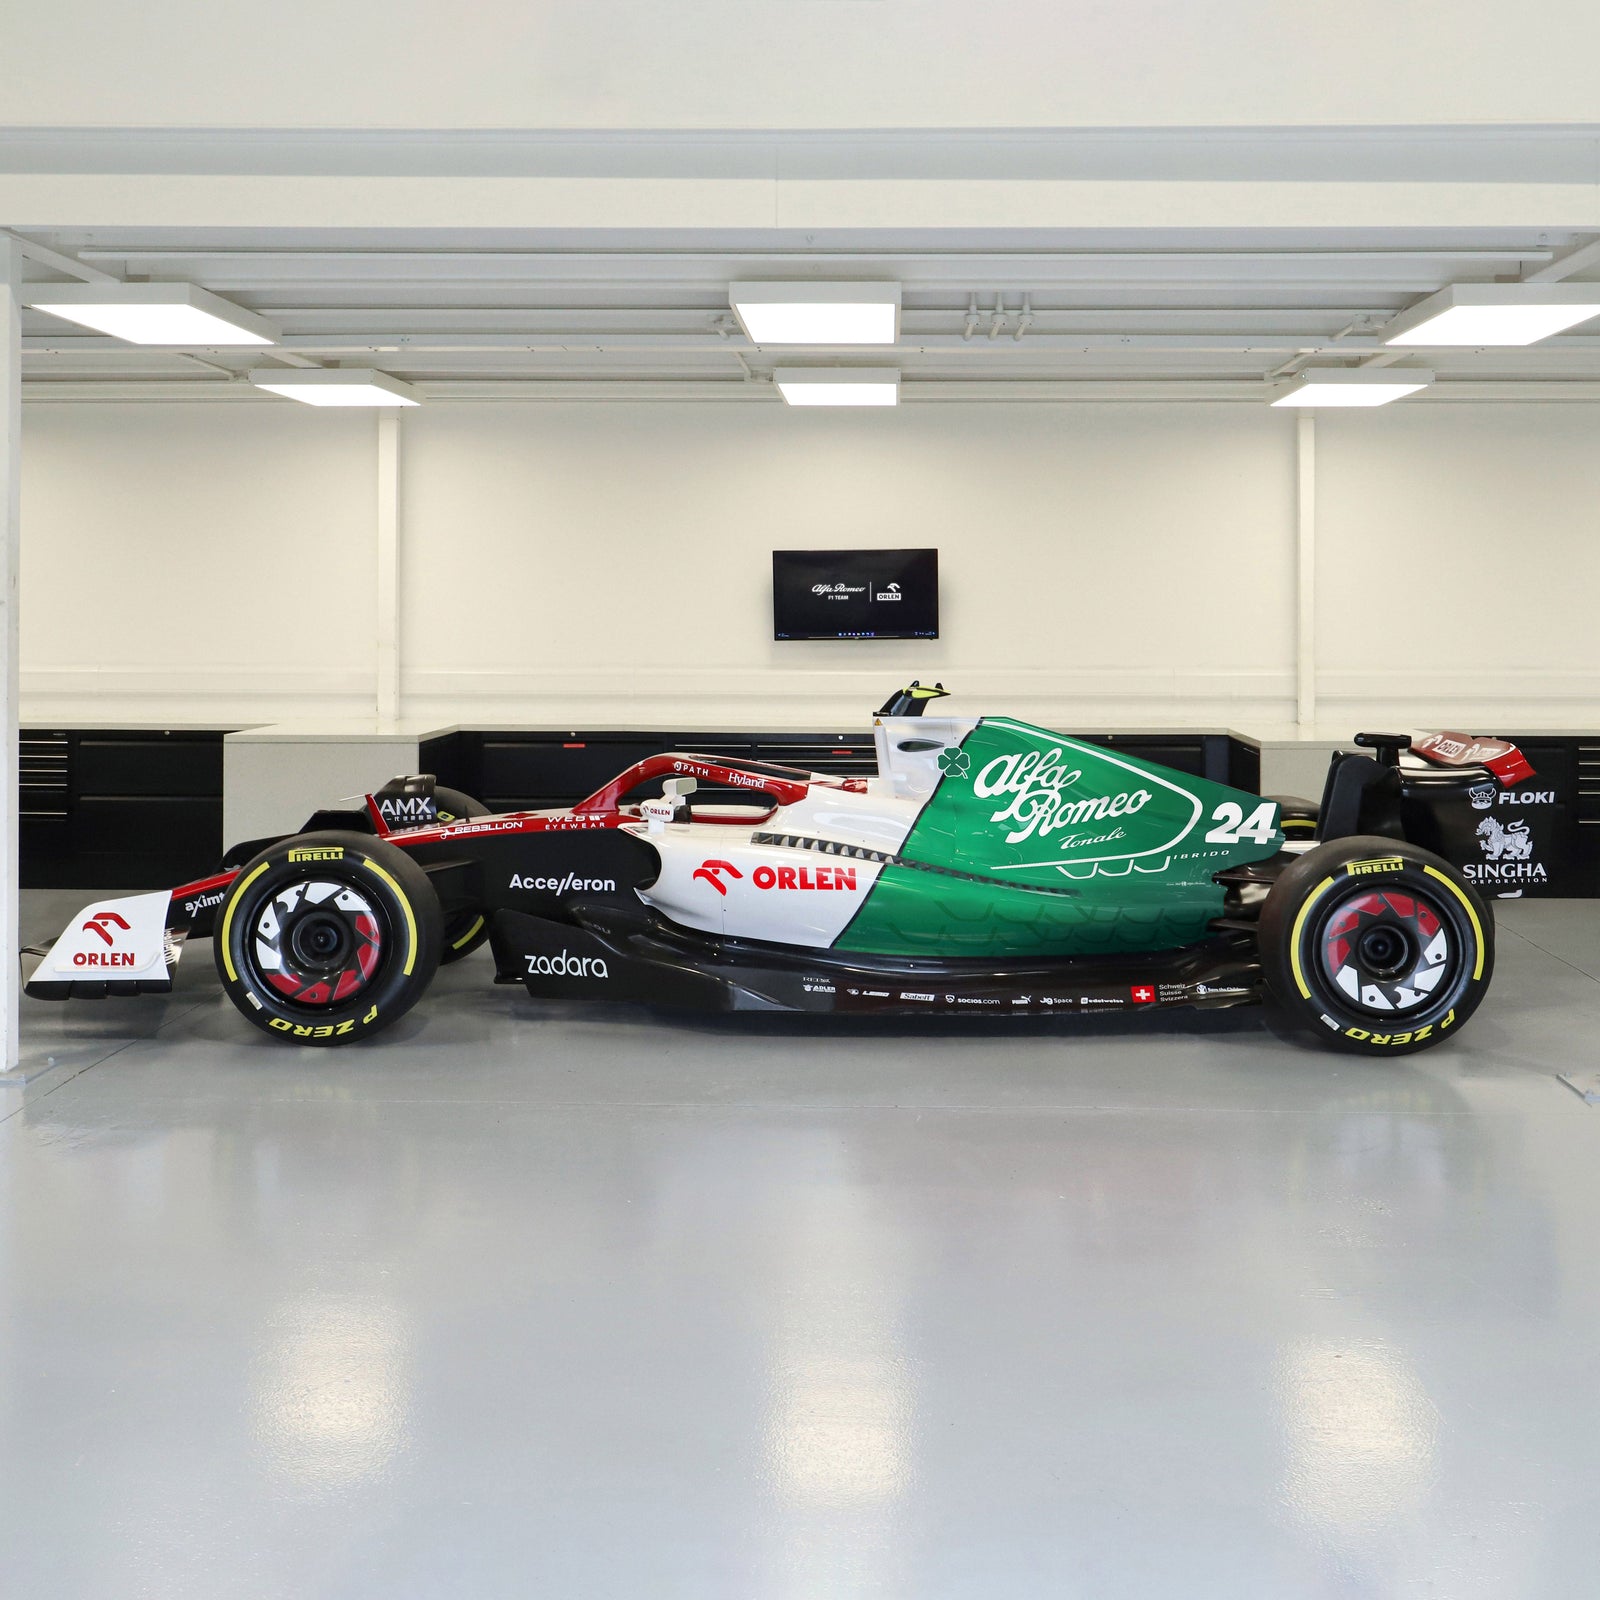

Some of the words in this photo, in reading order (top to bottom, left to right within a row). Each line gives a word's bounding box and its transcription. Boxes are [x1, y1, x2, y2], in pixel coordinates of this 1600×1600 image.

[728, 772, 765, 788] Hyland
[973, 747, 1082, 821] Alfa
[380, 797, 432, 815] AMX
[1498, 791, 1555, 804] FLOKI
[650, 808, 671, 816] ORLEN
[1004, 789, 1153, 844] Romeo
[545, 822, 605, 831] EYEWEAR
[1204, 801, 1277, 844] 24
[1058, 826, 1127, 850] Tonale
[288, 847, 344, 862] PIRELLI
[1173, 850, 1230, 860] IBRIDO
[1347, 857, 1404, 876] PIRELLI
[1463, 863, 1547, 879] SINGHA
[752, 866, 857, 891] ORLEN
[1471, 877, 1548, 885] ORPORATION
[73, 952, 135, 966] ORLEN
[524, 949, 609, 978] zadara
[363, 1004, 378, 1025] P
[1441, 1008, 1455, 1029] P
[269, 1018, 355, 1038] ZERO
[1345, 1024, 1433, 1046] ZERO
